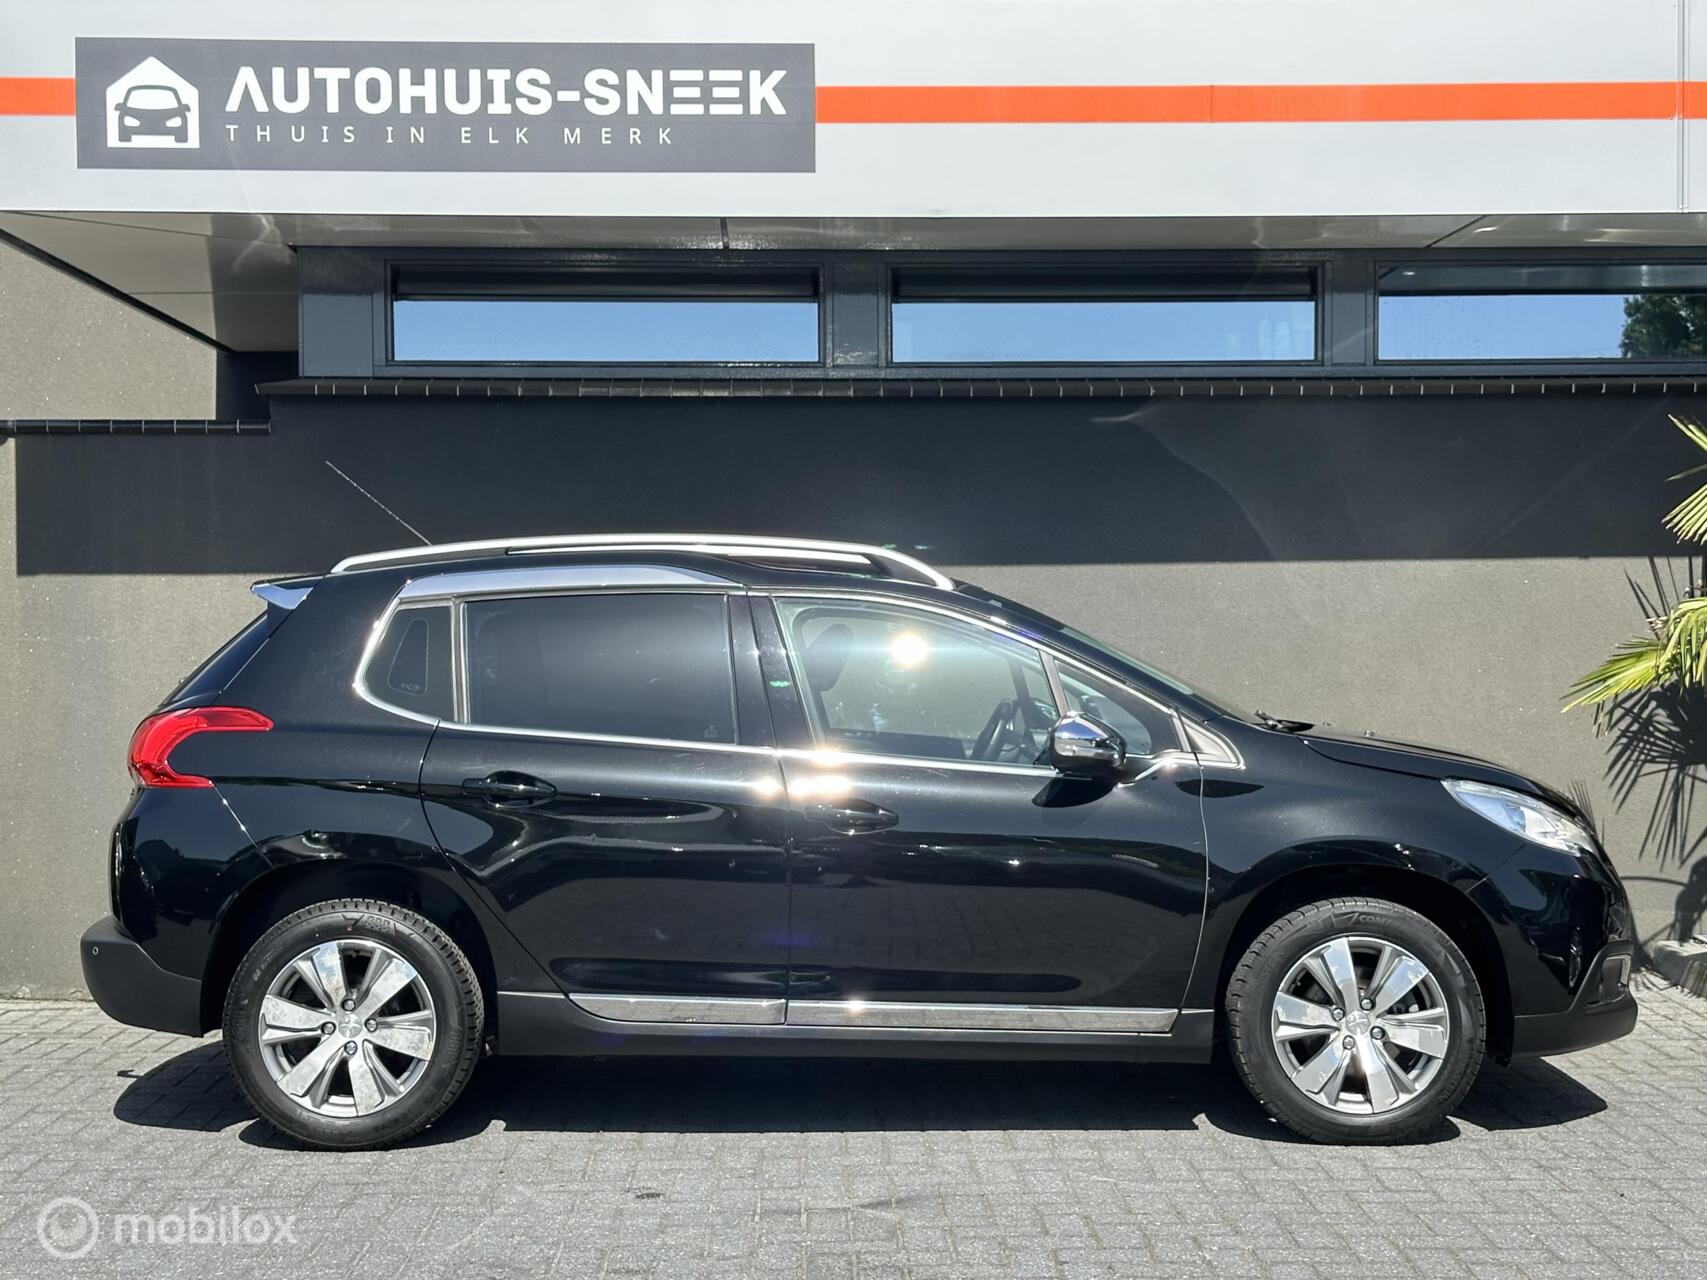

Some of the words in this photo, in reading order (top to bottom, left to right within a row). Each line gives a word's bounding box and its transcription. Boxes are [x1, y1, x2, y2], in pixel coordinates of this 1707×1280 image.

[225, 66, 787, 116] AUTOHUIS-SNEEK
[225, 124, 356, 144] THUIS
[385, 125, 425, 144] IN
[460, 126, 529, 145] ELK
[563, 126, 673, 145] MERK
